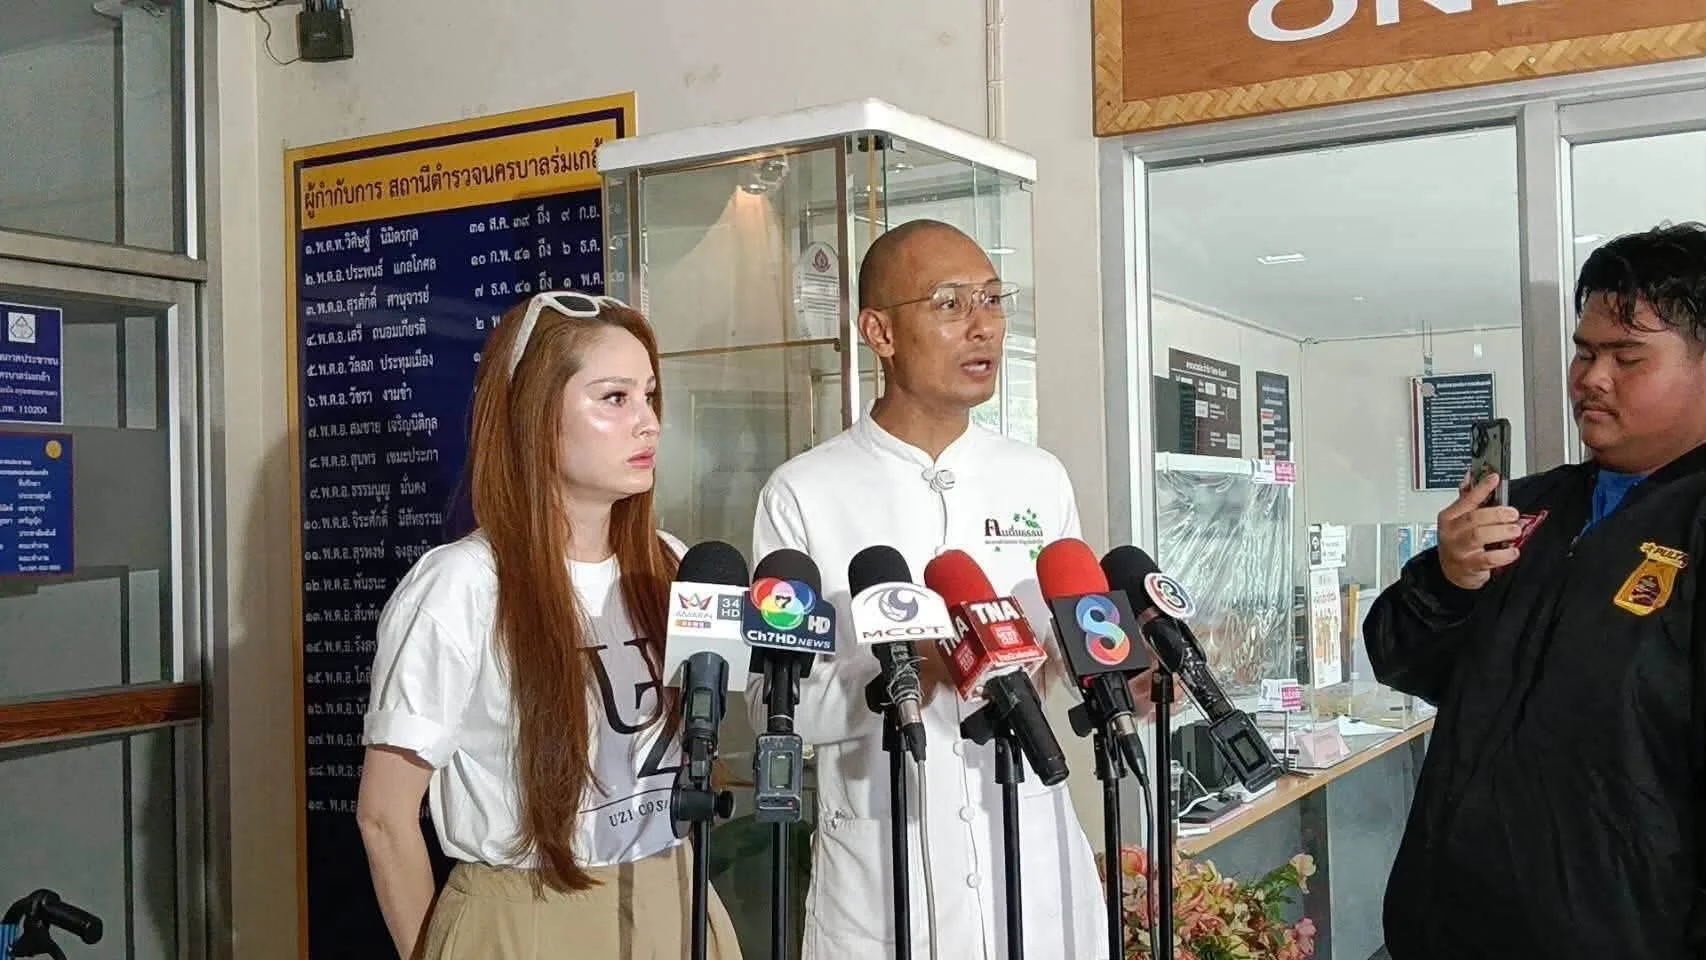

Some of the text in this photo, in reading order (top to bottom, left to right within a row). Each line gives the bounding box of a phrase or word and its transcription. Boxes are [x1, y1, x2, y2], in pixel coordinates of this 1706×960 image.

[304, 137, 603, 220] ผู้กำกับการ สถานีตำรวจนครบาลร่มเกล้
[537, 203, 550, 225] ถึง
[579, 205, 600, 220] ก.ย.
[538, 237, 552, 258] ถึง
[580, 238, 600, 253] ธ.ค.
[539, 271, 552, 291] ถึง
[721, 598, 741, 609] 34
[721, 608, 741, 618] HD
[969, 600, 1021, 625] TNA
[807, 615, 831, 635] HD
[862, 625, 945, 640] MCOT
[747, 630, 831, 650] Ch7HD NEWS
[609, 799, 669, 828] UZI COS
